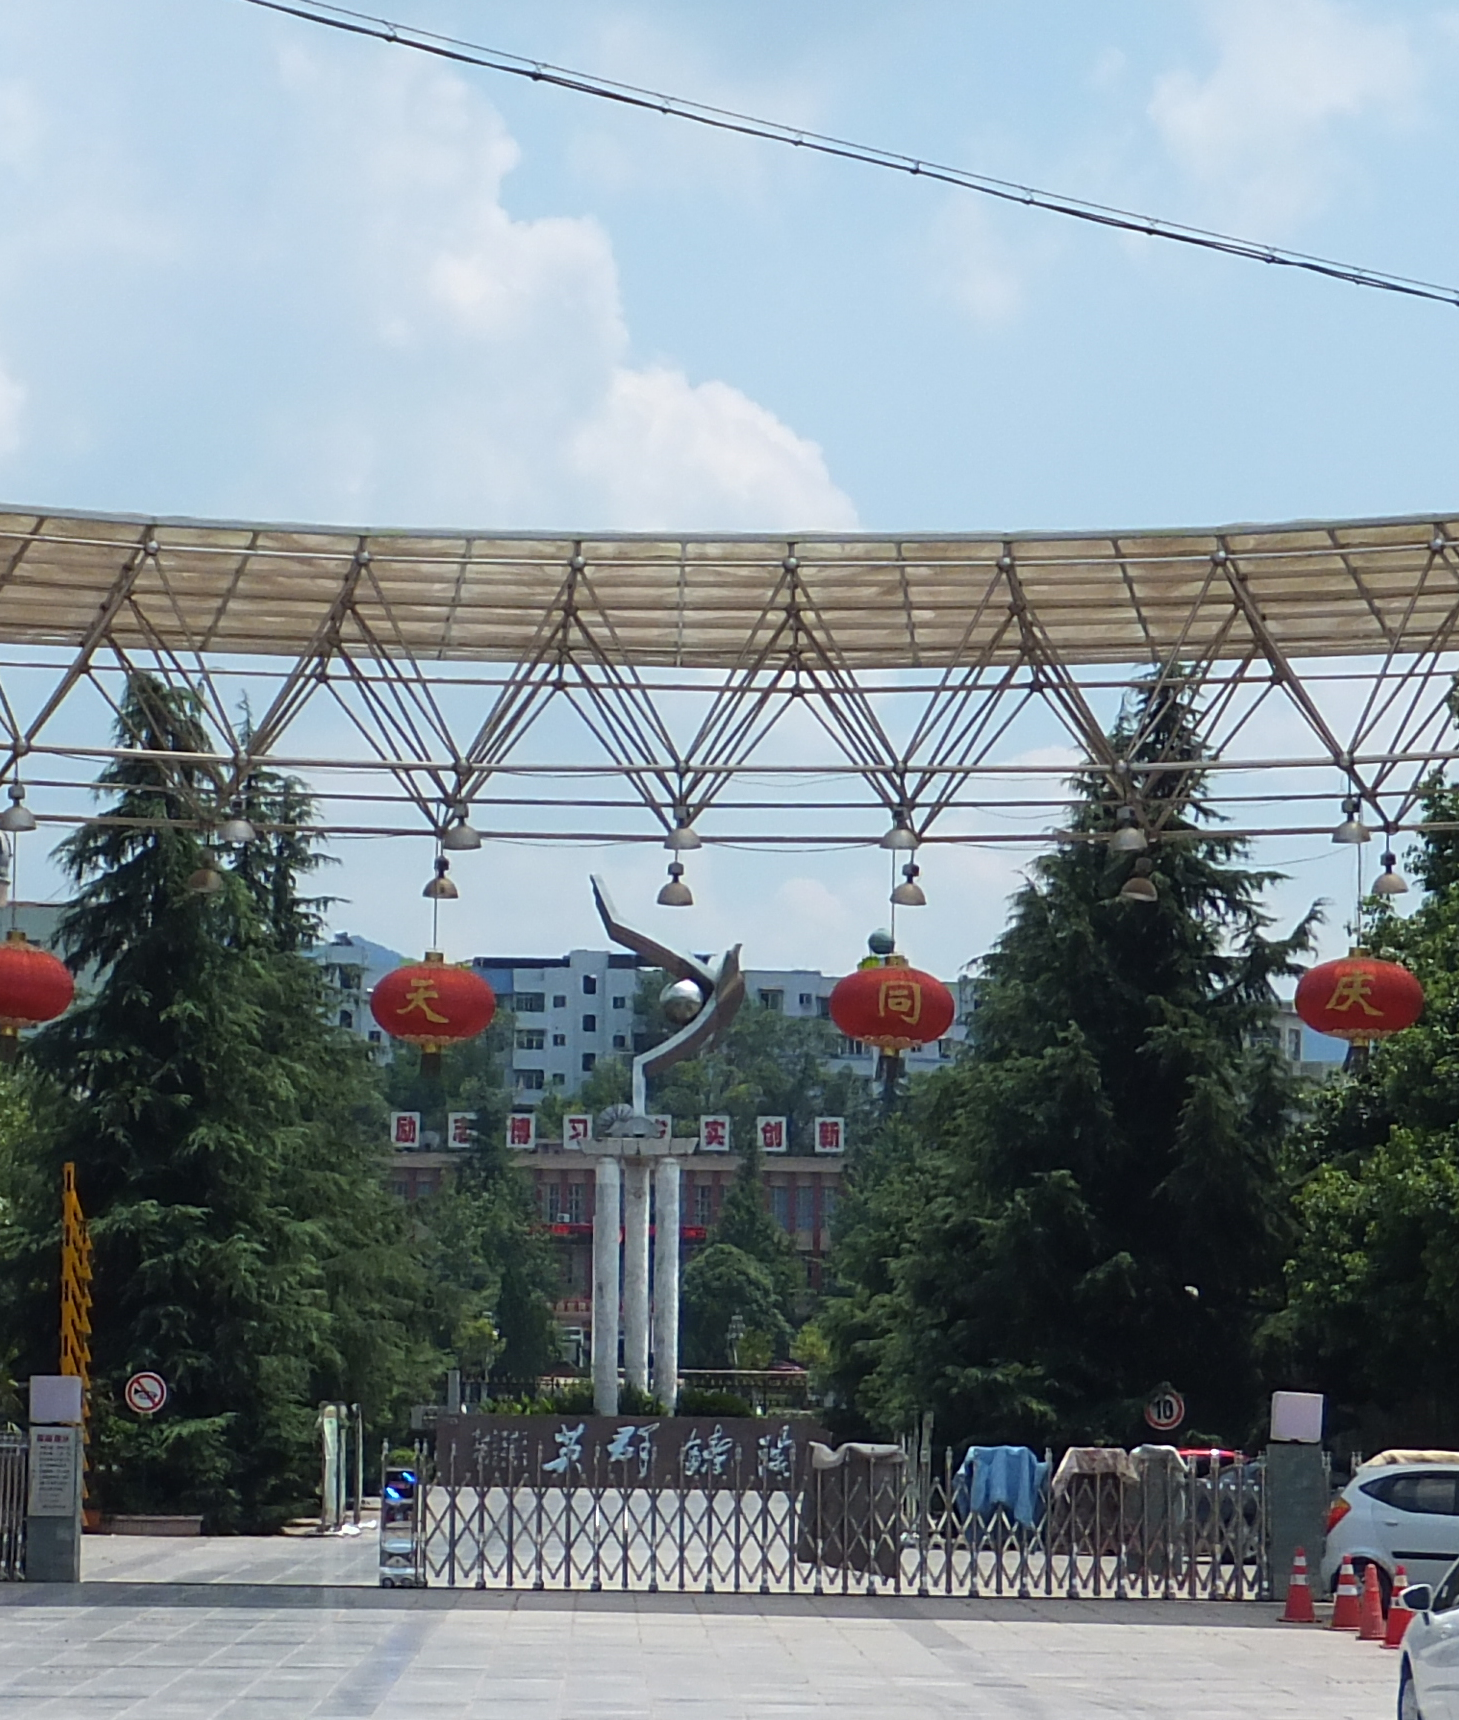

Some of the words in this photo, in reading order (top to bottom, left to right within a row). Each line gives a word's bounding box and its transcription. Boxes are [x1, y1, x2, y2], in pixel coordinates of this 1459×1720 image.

[396, 977, 450, 1024] 天
[878, 980, 921, 1026] 同
[1325, 968, 1384, 1017] 庆
[1154, 1399, 1174, 1420] 10
